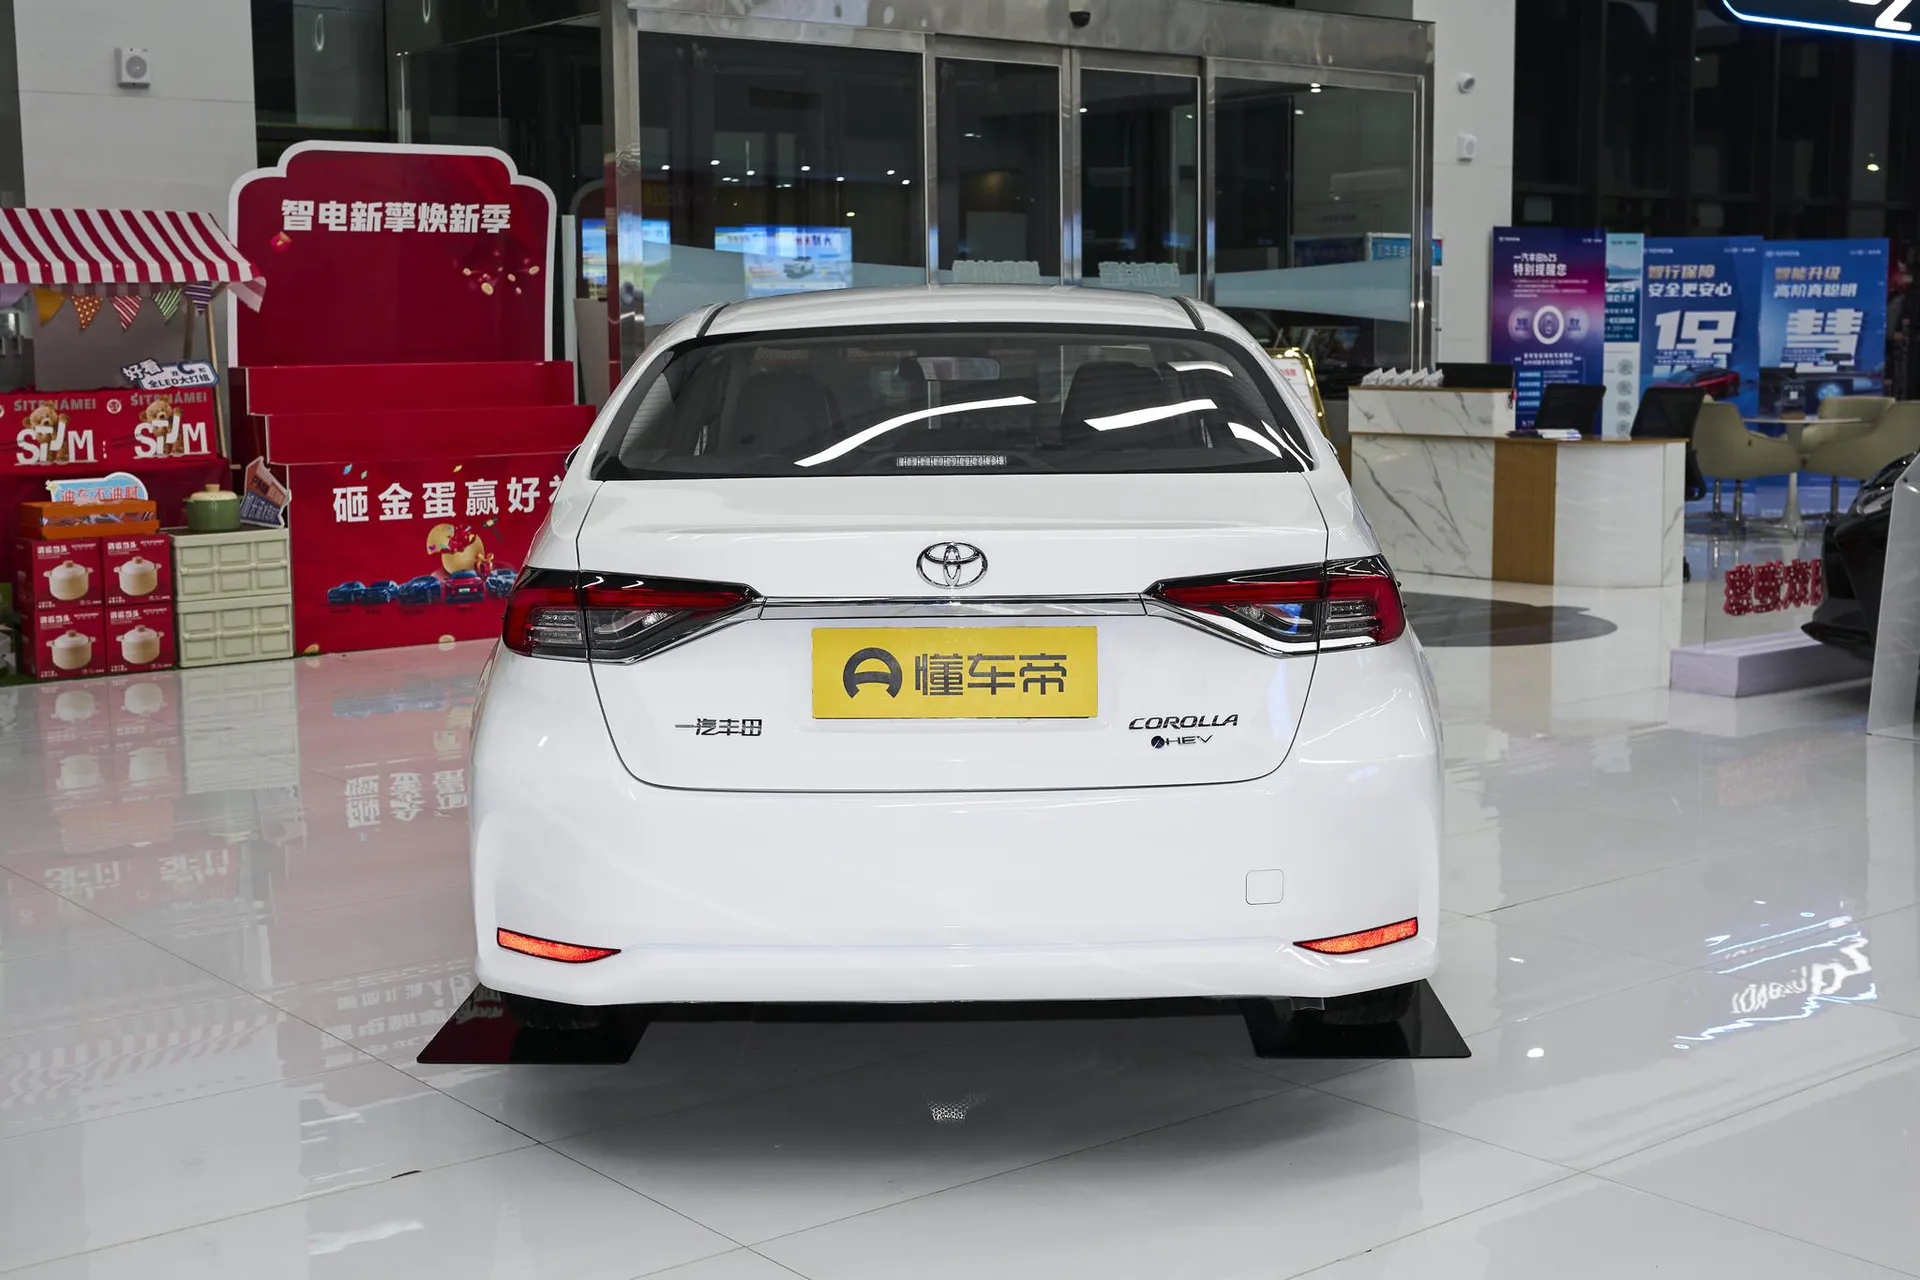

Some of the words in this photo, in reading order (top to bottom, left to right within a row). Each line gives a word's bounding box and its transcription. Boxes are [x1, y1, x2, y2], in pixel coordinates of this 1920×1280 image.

[281, 199, 511, 234] 智电新擎焕新季
[1648, 281, 1732, 297] 安全更安心
[914, 653, 1067, 696] 懂车帝
[674, 718, 763, 737] 一汽丰田
[1128, 713, 1239, 730] COROLLA
[1165, 734, 1213, 746] HEV
